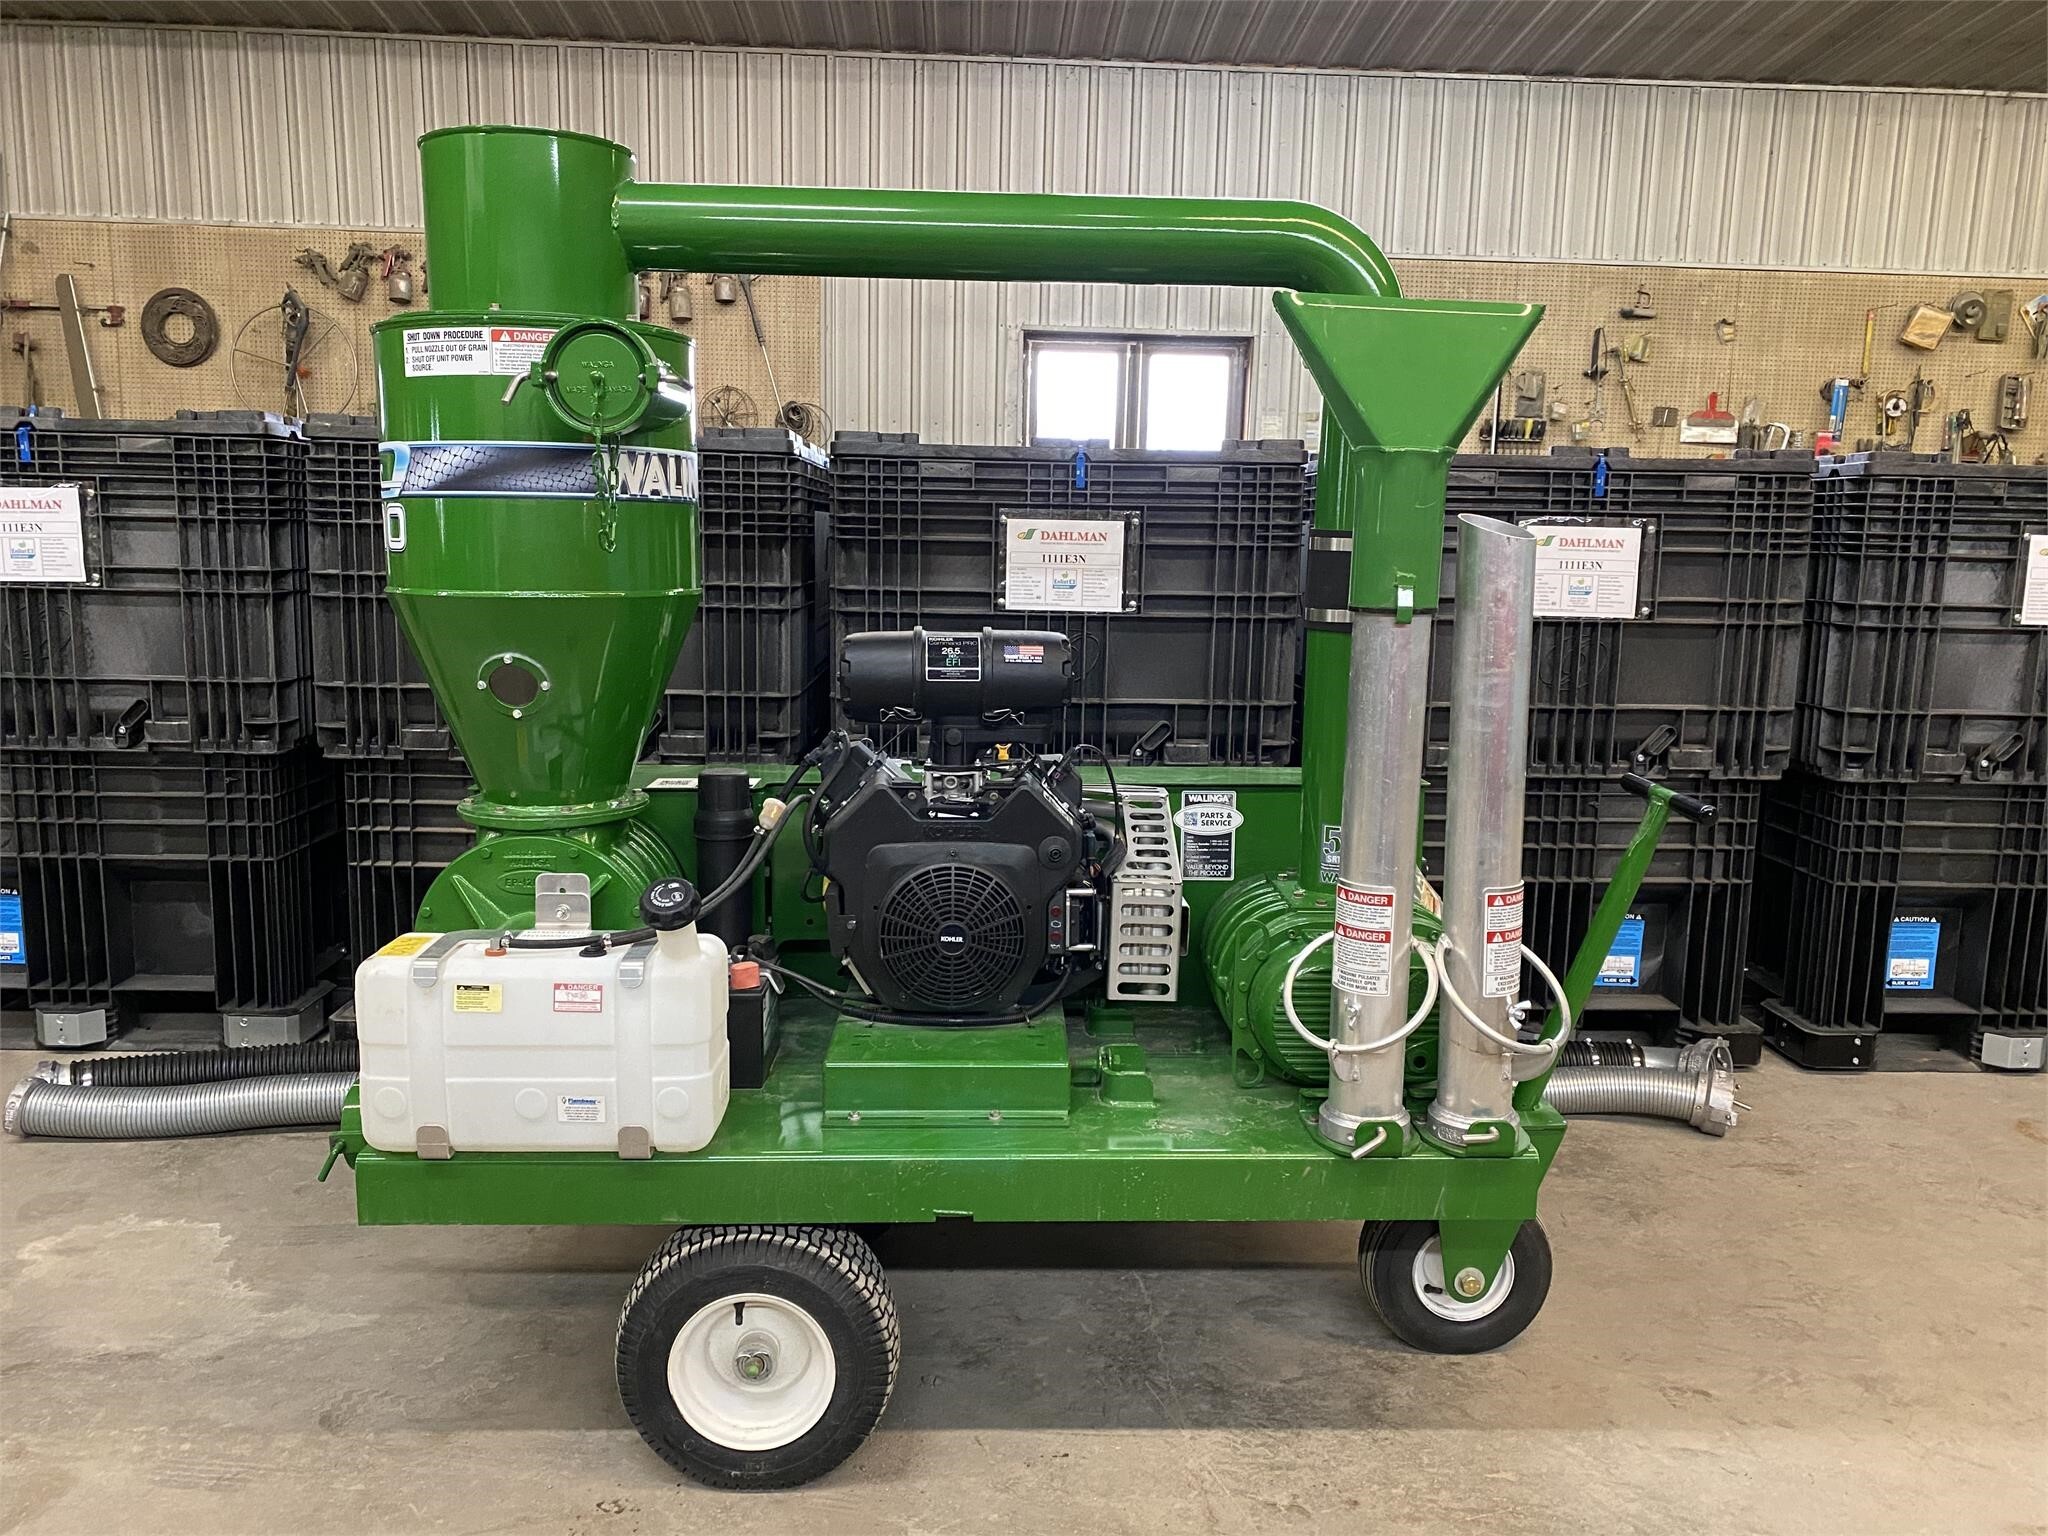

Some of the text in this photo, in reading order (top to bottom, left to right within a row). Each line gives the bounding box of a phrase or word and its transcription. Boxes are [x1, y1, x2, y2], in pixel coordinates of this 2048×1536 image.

[407, 330, 484, 342] SHUT DOWN PROCEDURE
[412, 346, 424, 354] PULL
[469, 344, 488, 352] GRAIN
[450, 354, 473, 362] POWER
[1041, 531, 1108, 542] DAHLMAN
[1559, 537, 1624, 549] DAHLMAN
[1042, 554, 1087, 563] 1111E3N
[1559, 560, 1603, 570] 1111E3N
[1188, 794, 1229, 802] WALINGA
[1348, 891, 1389, 905] DANGER
[1346, 928, 1386, 941] DANGER
